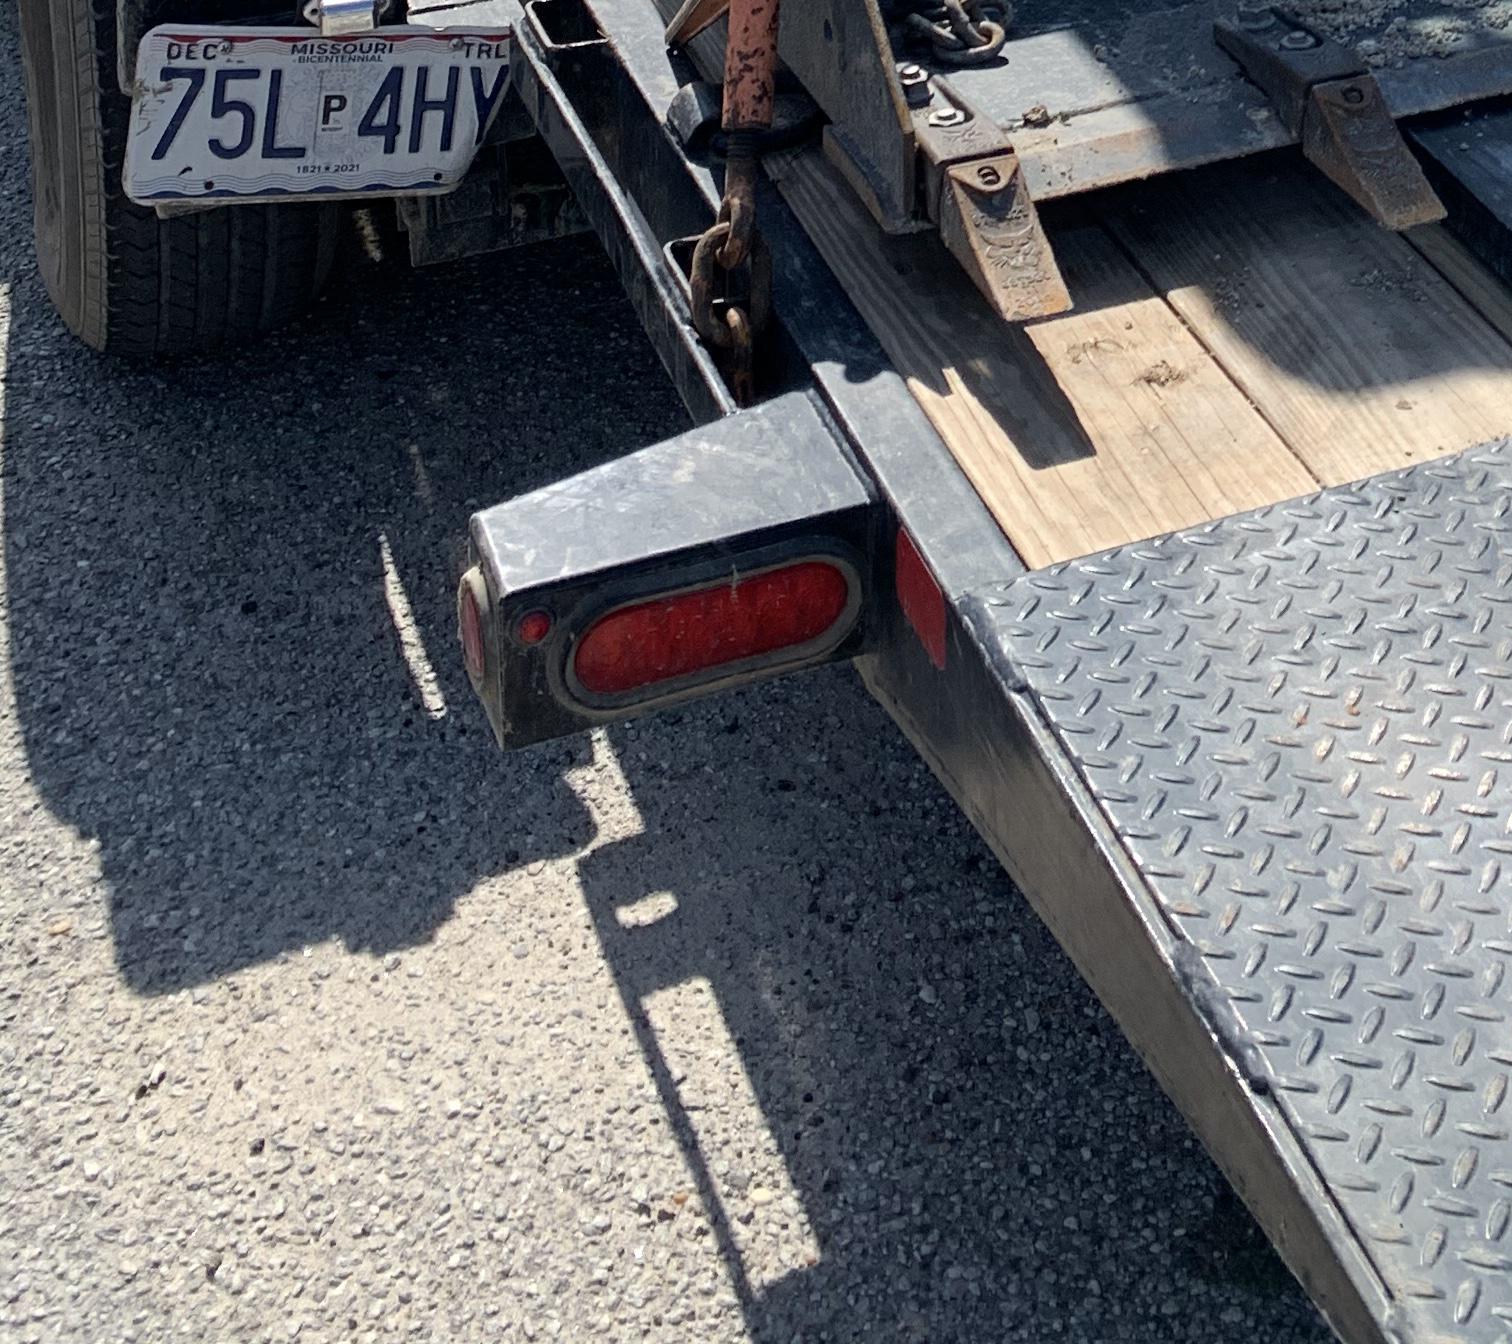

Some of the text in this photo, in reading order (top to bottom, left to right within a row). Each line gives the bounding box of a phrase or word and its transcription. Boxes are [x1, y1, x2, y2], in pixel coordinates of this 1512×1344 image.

[167, 42, 218, 61] DEC
[291, 42, 394, 55] MISSOURI
[464, 41, 507, 59] TRL
[298, 54, 384, 64] BICENTENNIAL
[151, 64, 510, 160] 75L 4HY
[322, 94, 348, 125] P
[297, 163, 361, 174] 1821 2021
